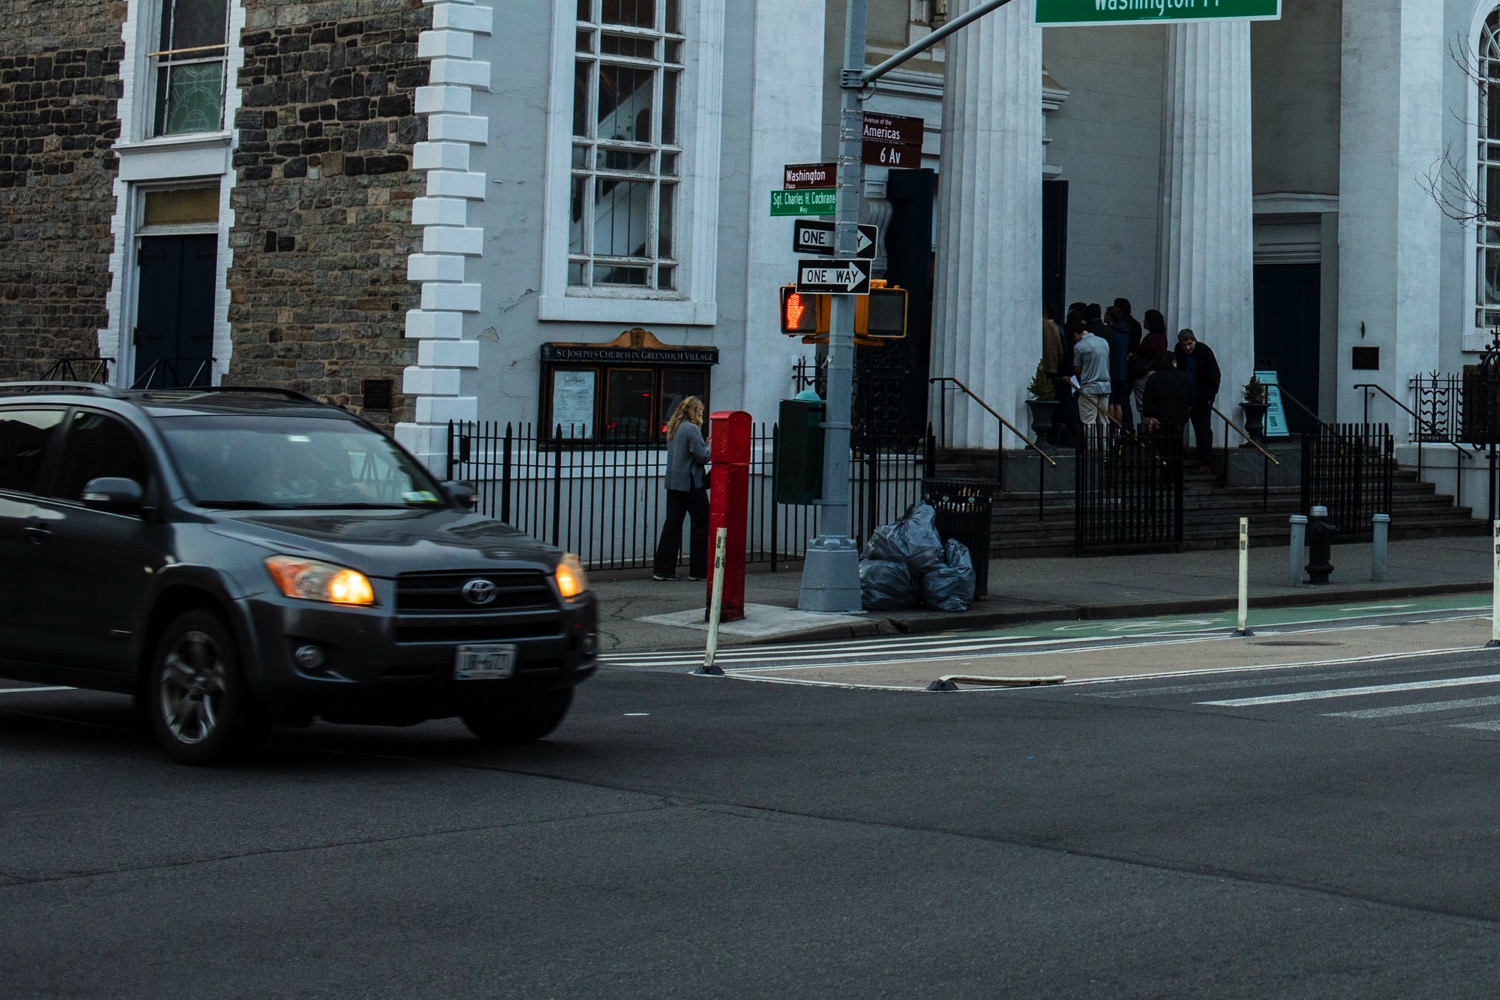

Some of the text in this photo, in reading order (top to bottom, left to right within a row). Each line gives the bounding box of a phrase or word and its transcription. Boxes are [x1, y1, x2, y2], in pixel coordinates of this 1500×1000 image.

[864, 116, 880, 125] Avenue
[885, 118, 893, 126] the
[863, 123, 901, 140] Americas
[880, 147, 901, 164] 6 Av
[786, 169, 826, 185] Washington
[772, 191, 836, 209] Sgt. Charles H. Cochrane
[799, 206, 808, 214] Way
[802, 230, 825, 245] ONE
[807, 269, 859, 283] ONE WAY
[600, 351, 630, 359] CHURCH
[631, 351, 640, 359] IN
[641, 351, 683, 360] GREENWICH
[684, 352, 714, 361] VILLAGE
